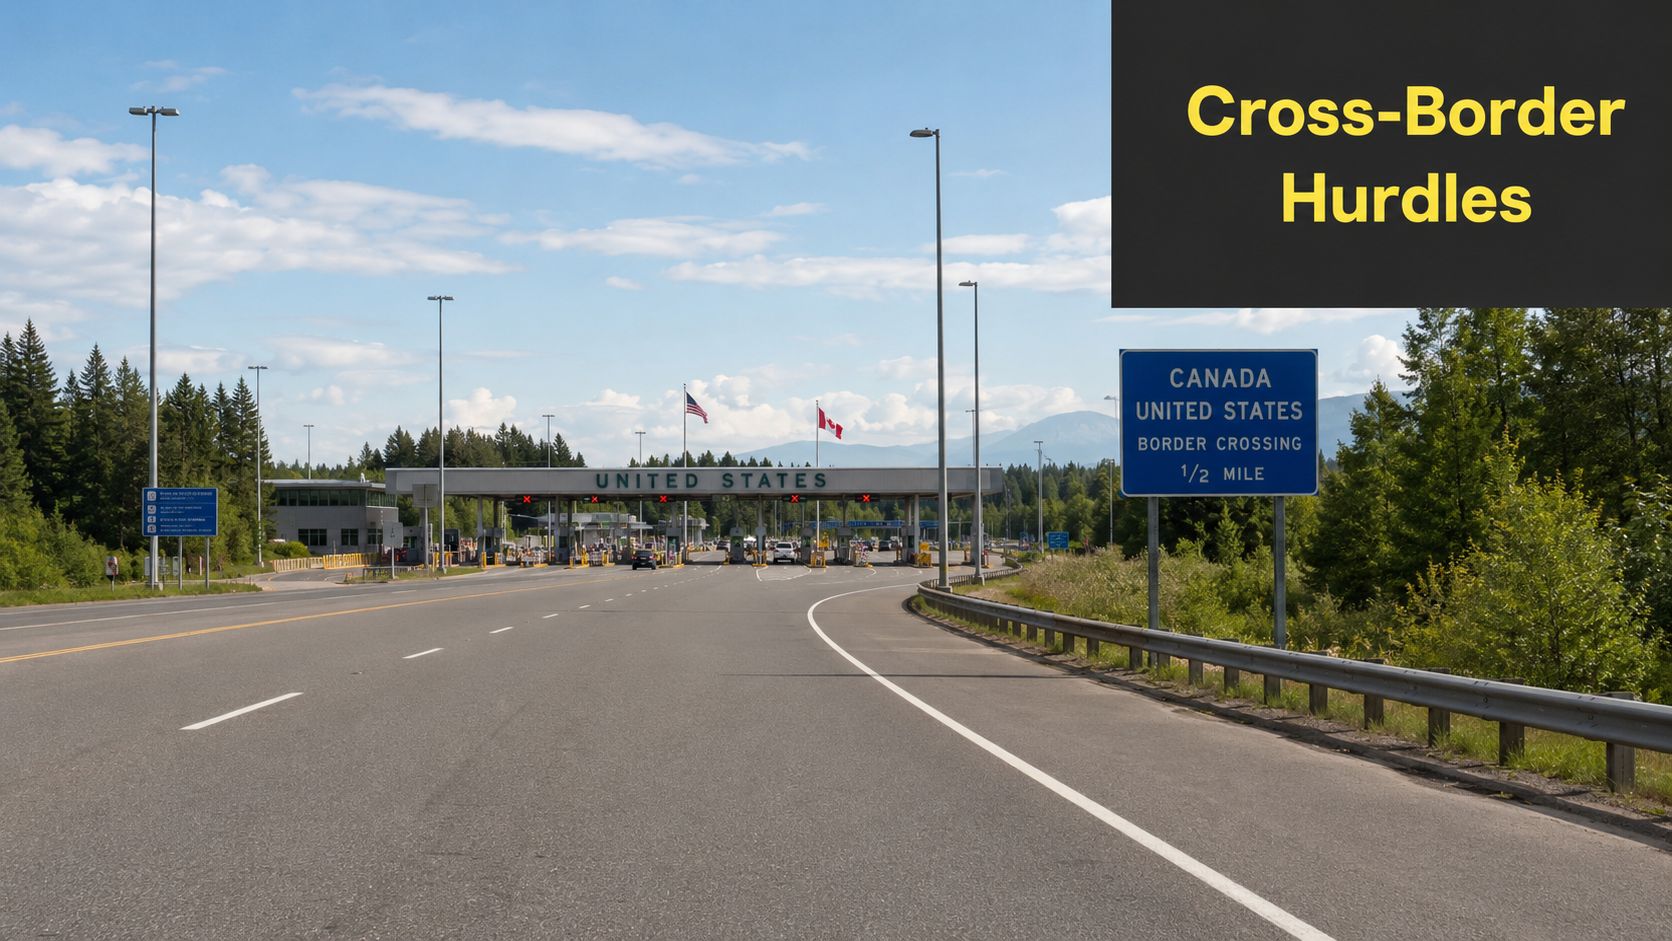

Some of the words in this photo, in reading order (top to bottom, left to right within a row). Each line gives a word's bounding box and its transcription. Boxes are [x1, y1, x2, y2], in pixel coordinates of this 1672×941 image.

[1169, 368, 1272, 388] CANADA
[1136, 401, 1213, 420] UNITED
[1224, 401, 1303, 420] STATES
[1138, 436, 1207, 451] BORDER
[1216, 436, 1302, 451] CROSSING
[596, 472, 699, 489] UNITED
[722, 472, 828, 489] STATES
[1181, 464, 1209, 483] 1/2
[1224, 466, 1265, 481] MILE
